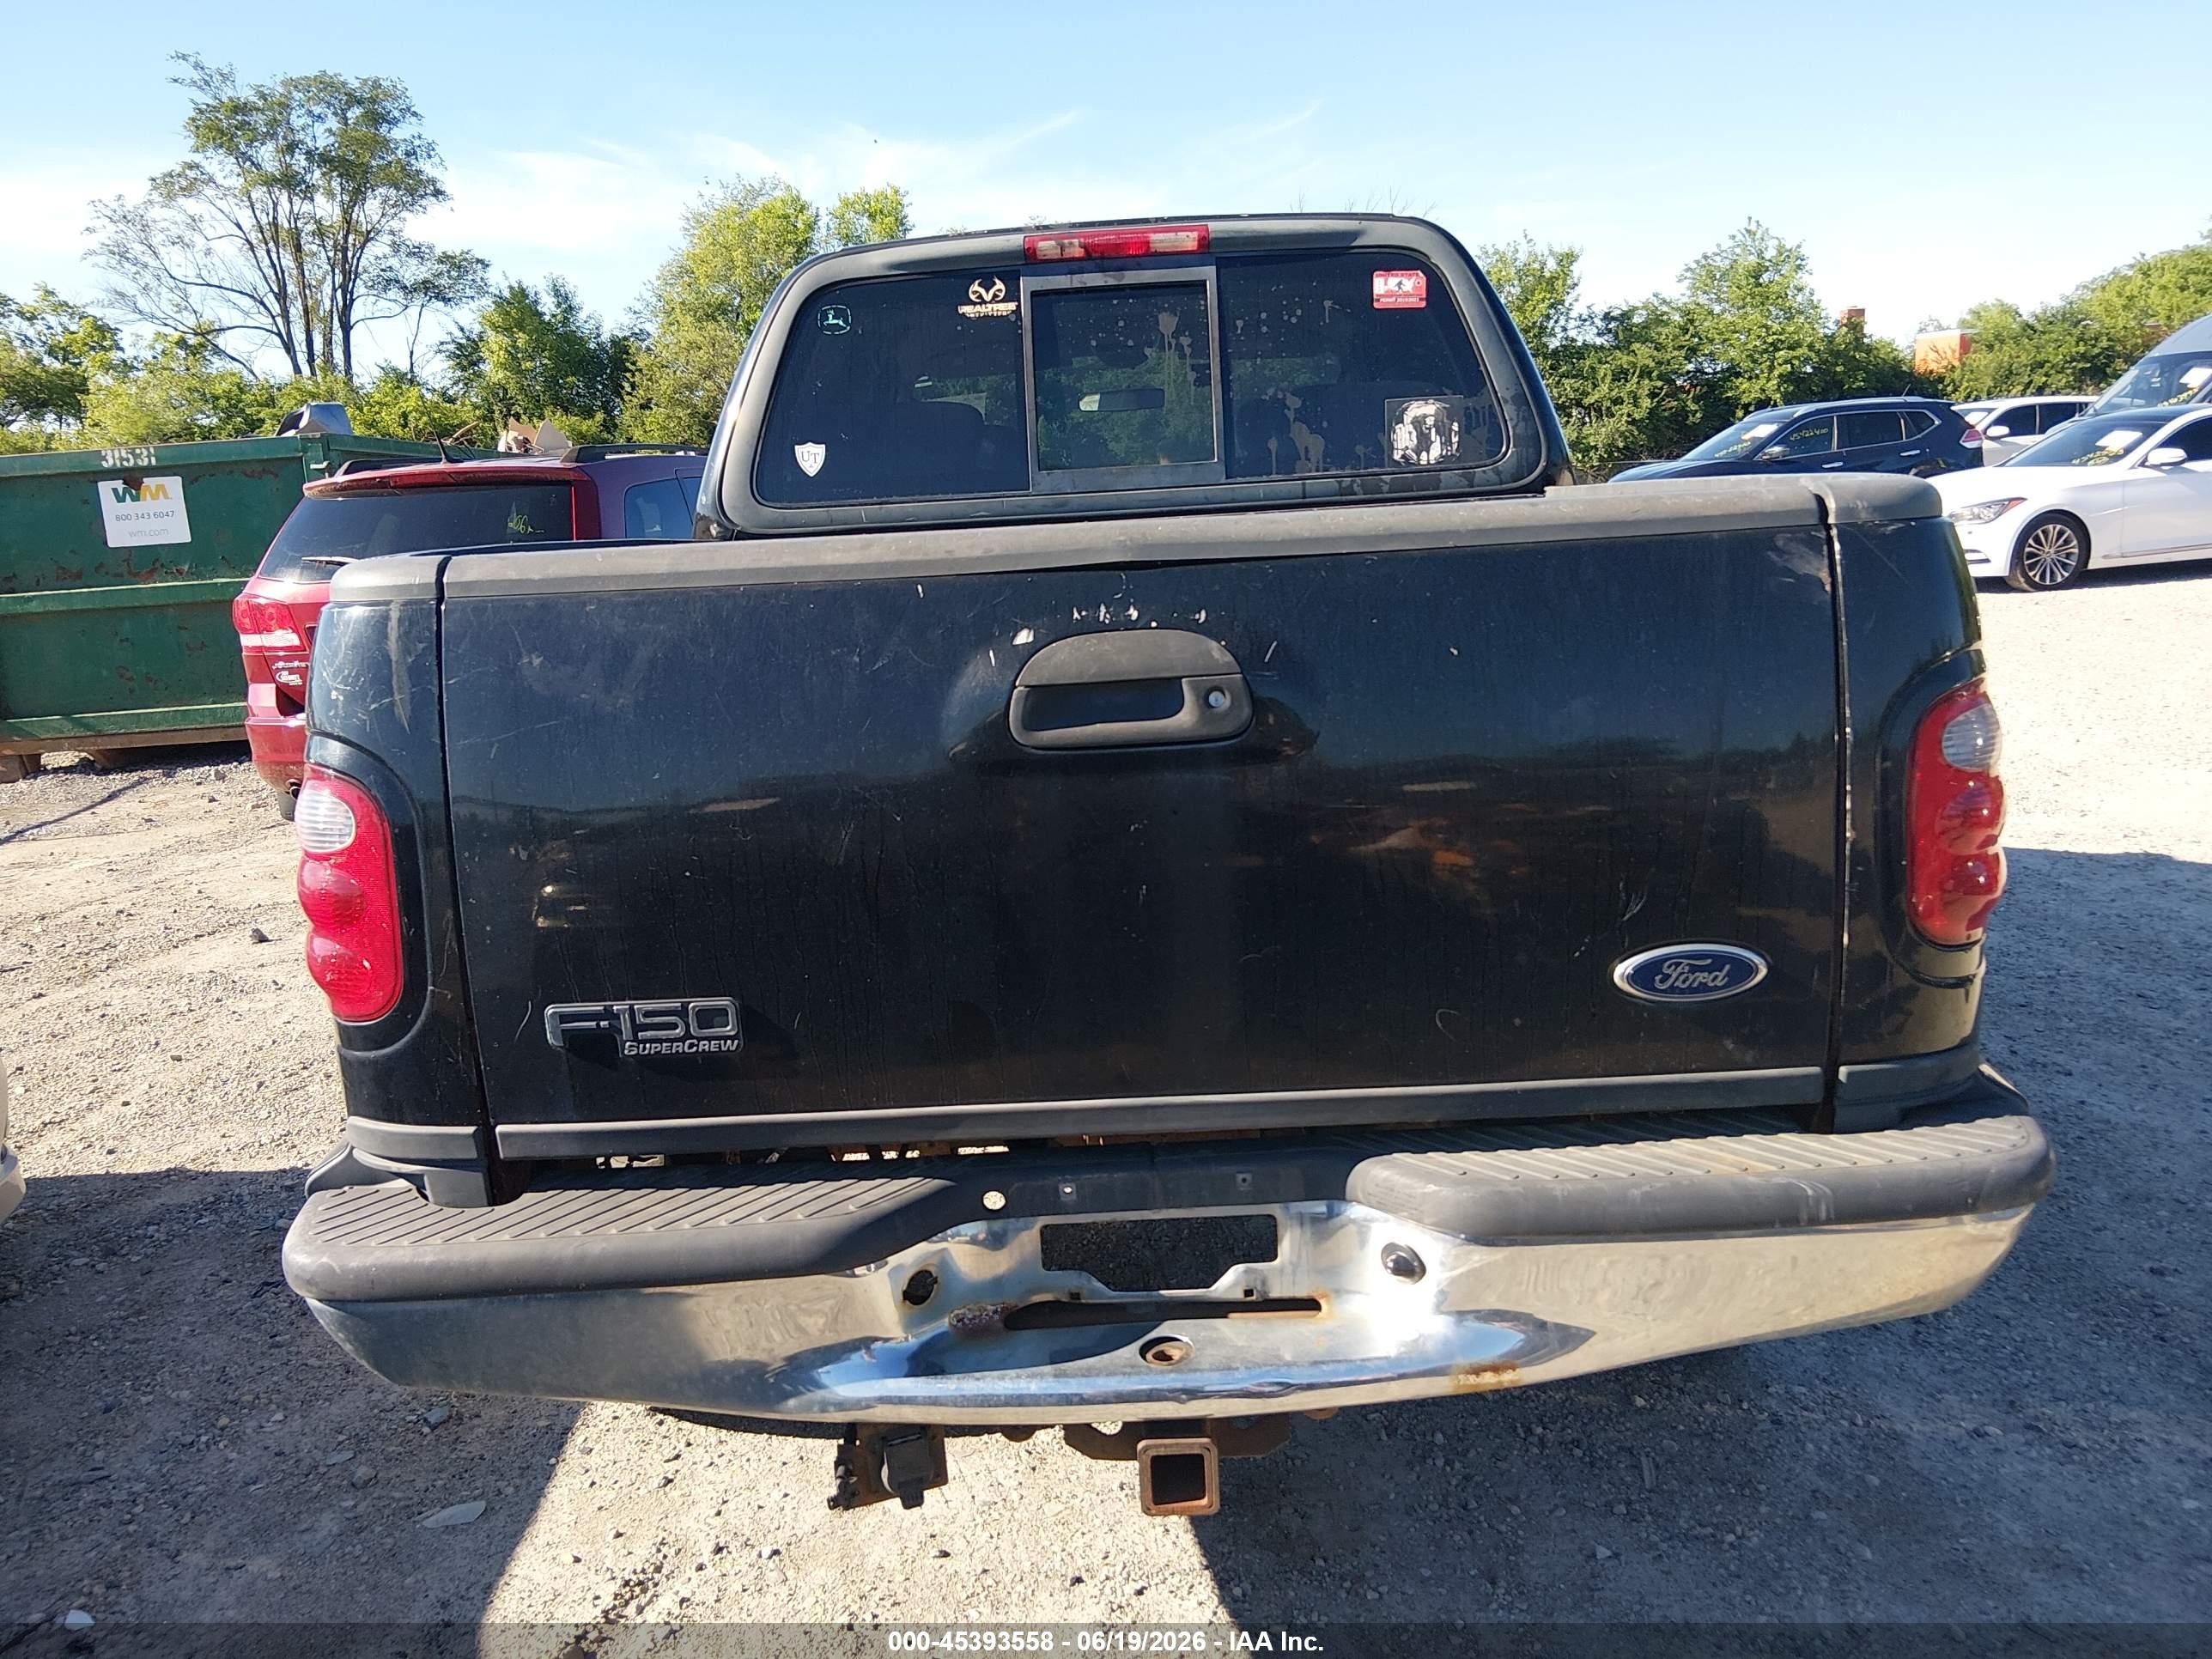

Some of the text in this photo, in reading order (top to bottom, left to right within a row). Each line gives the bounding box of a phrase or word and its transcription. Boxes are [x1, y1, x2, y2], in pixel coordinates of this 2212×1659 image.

[800, 450, 820, 464] UT
[111, 483, 171, 504] WM
[115, 510, 175, 522] 800 343 6047
[128, 528, 170, 538] wm.com
[1654, 958, 1731, 989] Ford
[544, 999, 740, 1047] F-150
